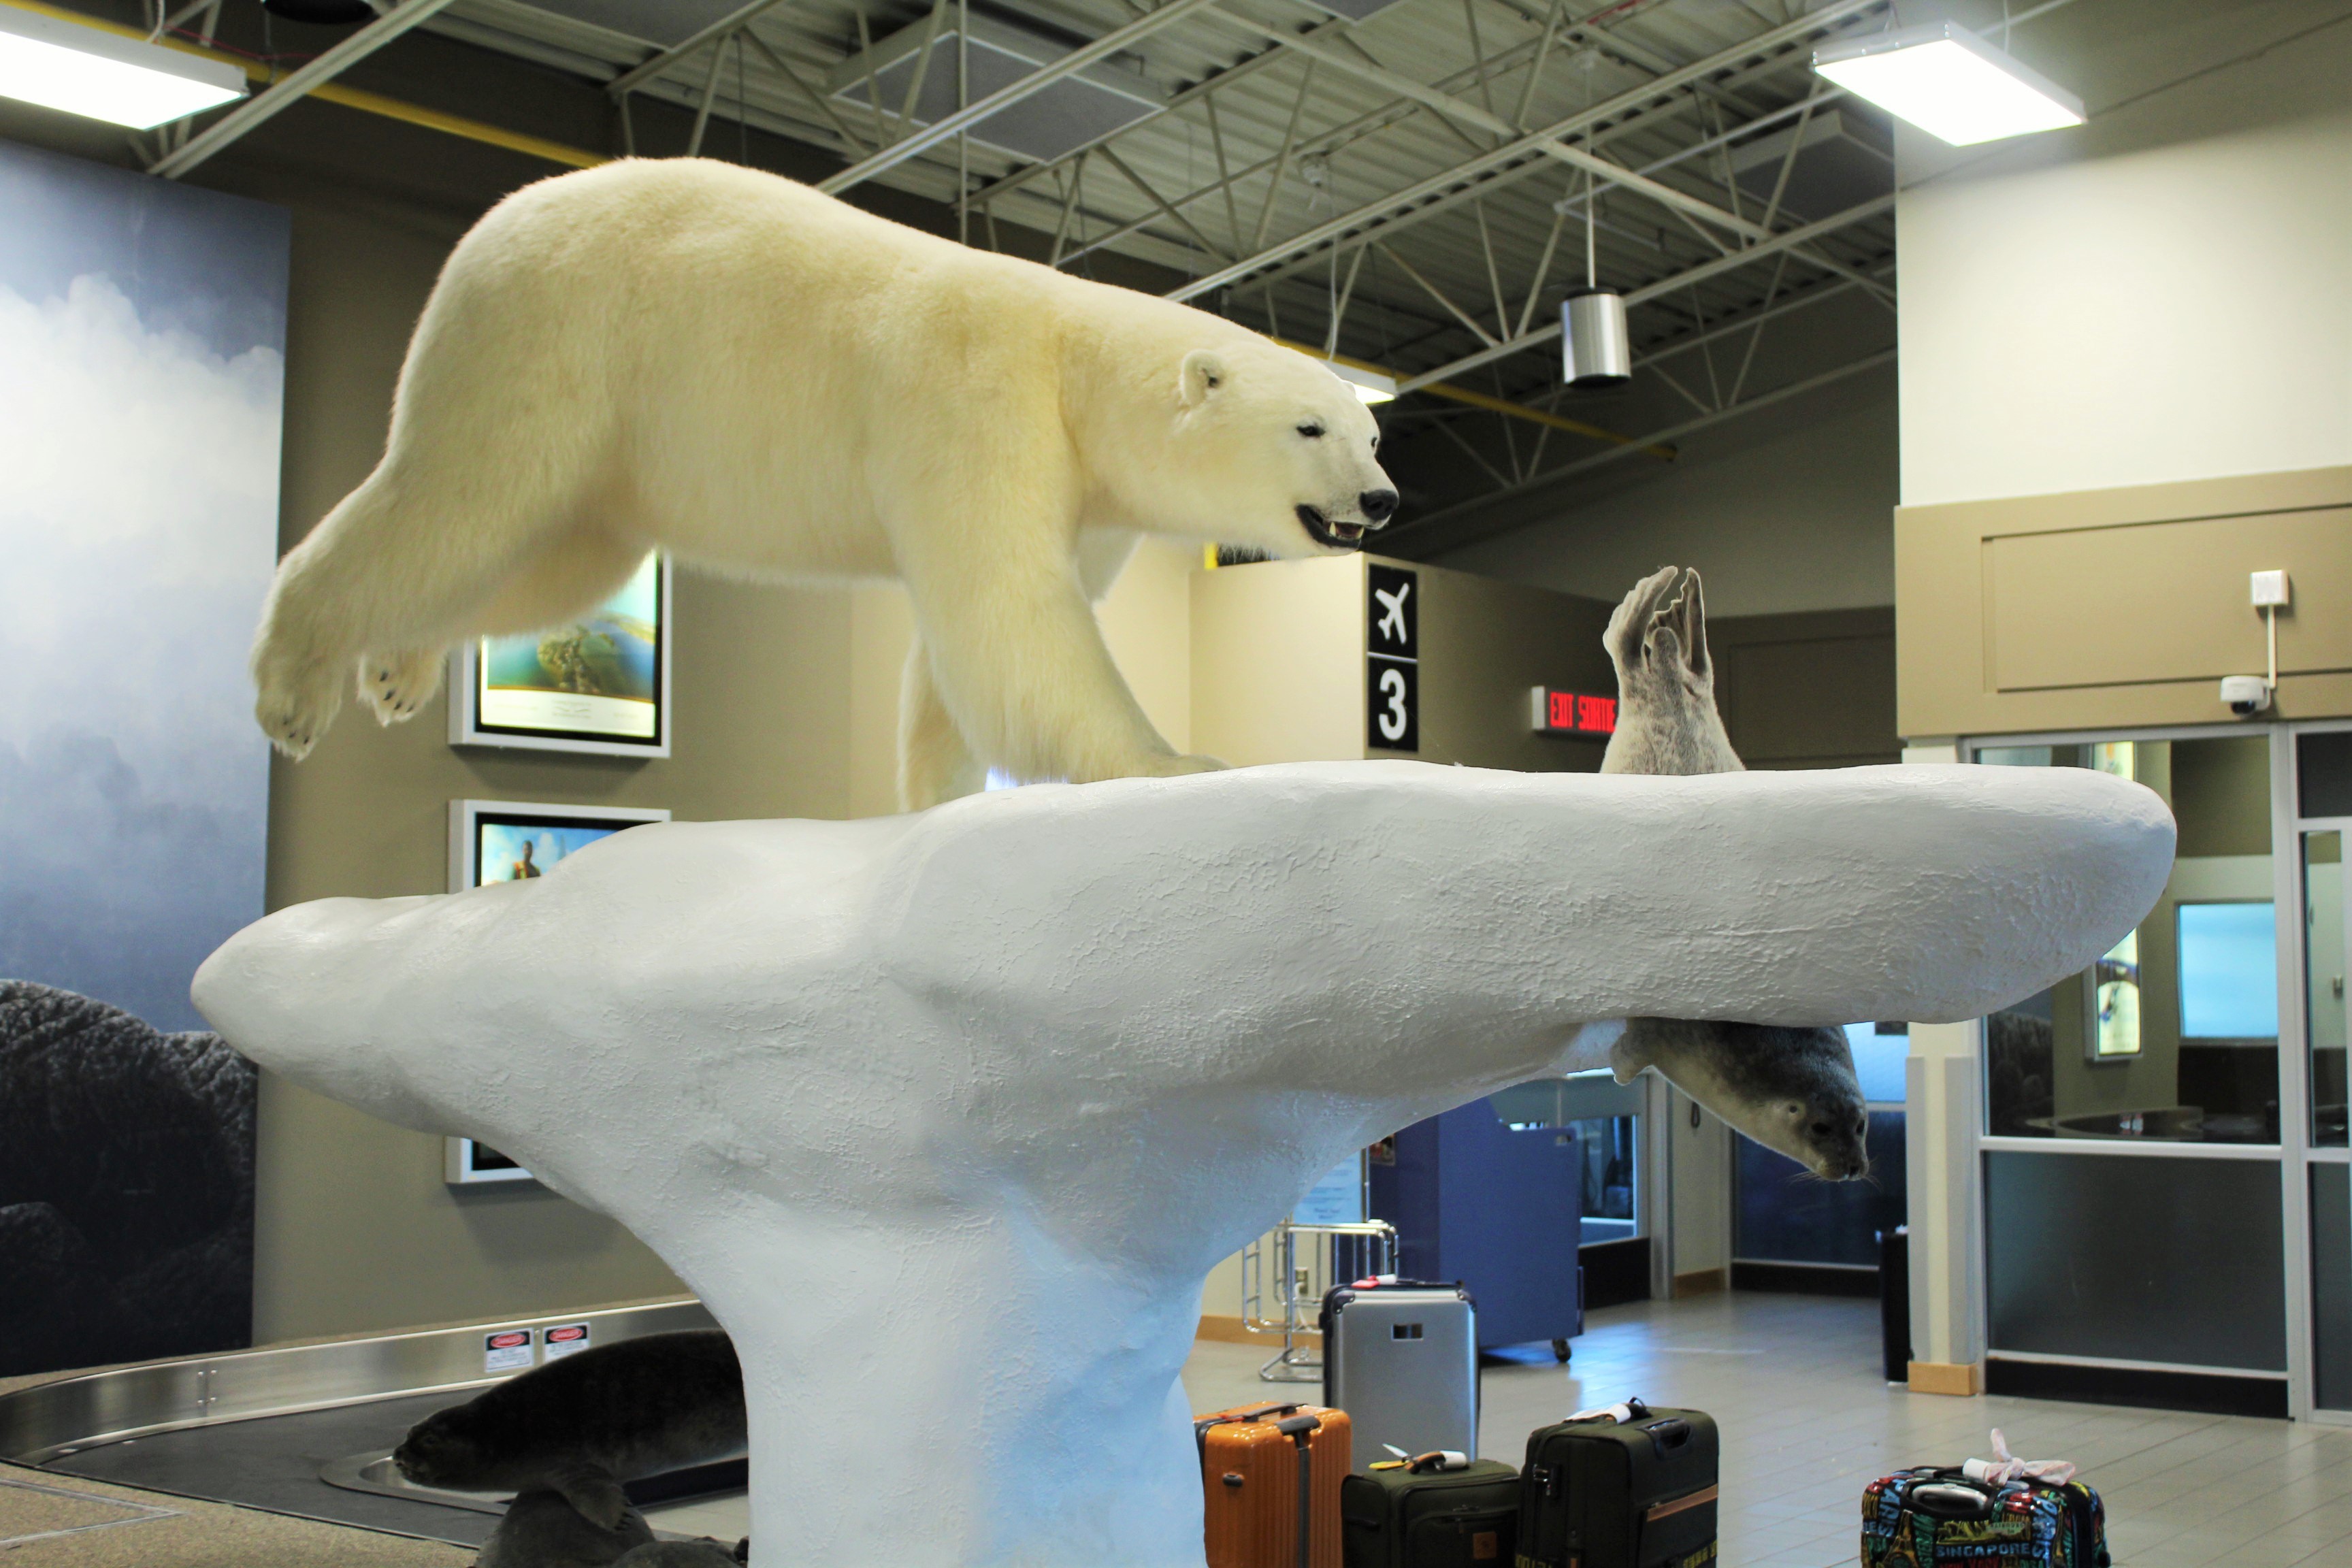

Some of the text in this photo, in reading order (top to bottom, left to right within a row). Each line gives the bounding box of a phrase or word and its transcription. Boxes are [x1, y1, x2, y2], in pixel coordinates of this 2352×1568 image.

[1379, 669, 1407, 740] 3
[1550, 691, 1616, 734] EXIT SORTIE
[1878, 1478, 1906, 1537] PARIS
[2031, 1496, 2057, 1558] PARIS
[1936, 1543, 2030, 1558] SINGAPORE
